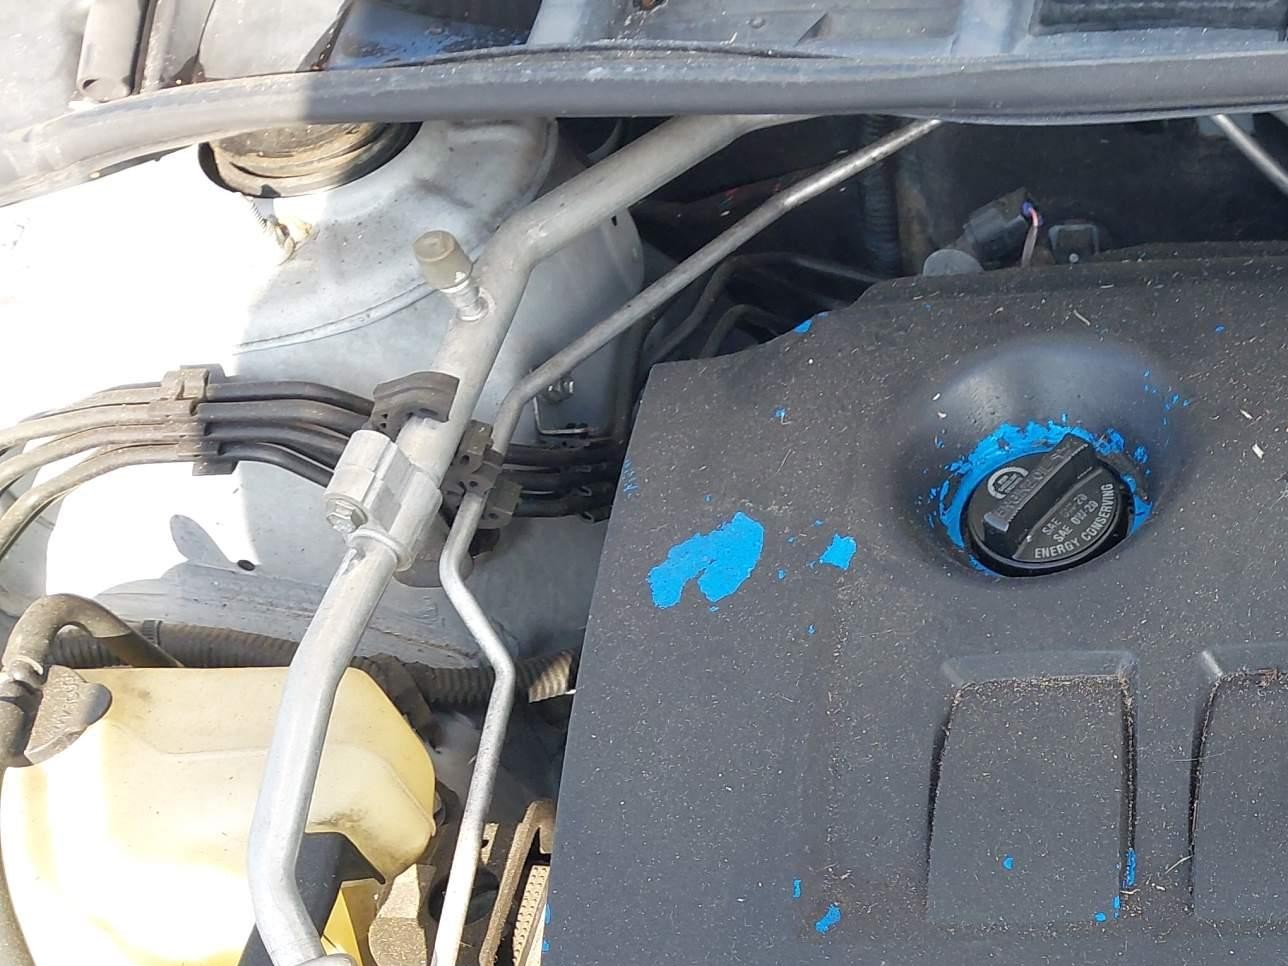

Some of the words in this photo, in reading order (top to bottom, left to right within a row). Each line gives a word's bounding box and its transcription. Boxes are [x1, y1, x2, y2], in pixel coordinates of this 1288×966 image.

[1034, 537, 1080, 559] ENERGY
[1081, 483, 1115, 541] CONSERVING
[1041, 517, 1062, 536] SAE
[1053, 525, 1074, 542] SAE
